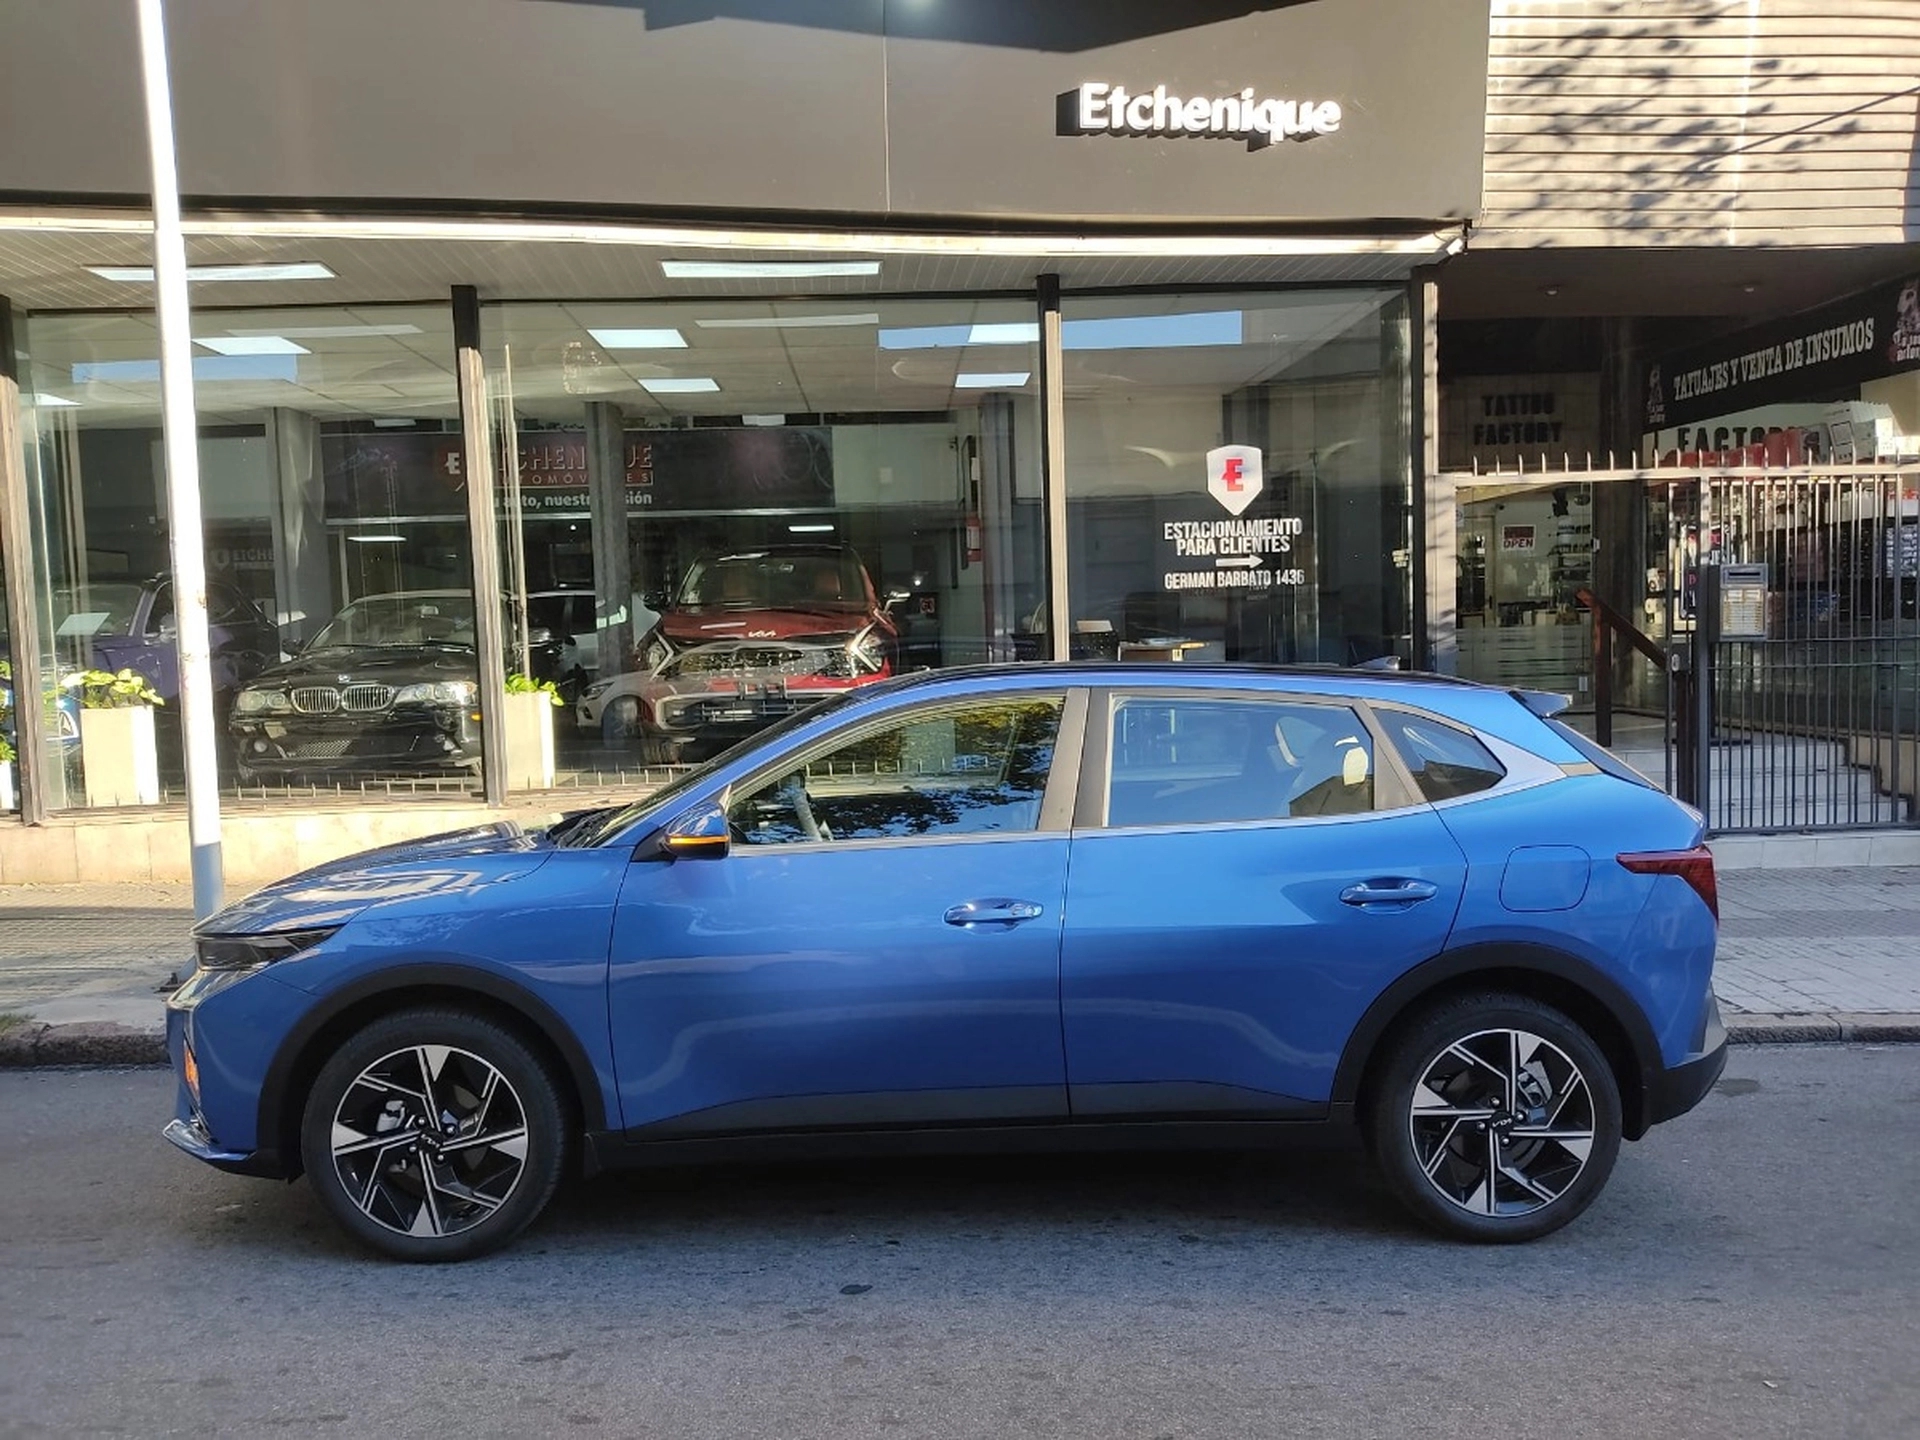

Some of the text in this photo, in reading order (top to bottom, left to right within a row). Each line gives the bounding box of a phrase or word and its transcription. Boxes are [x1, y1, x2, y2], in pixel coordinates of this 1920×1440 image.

[1078, 82, 1342, 144] Etchenique
[1673, 361, 1729, 401] TATUAJES
[1730, 358, 1739, 386] Y
[1741, 344, 1783, 382] VENTA
[1785, 338, 1803, 370] DE
[1805, 317, 1875, 365] INSUMOS
[1677, 426, 1798, 453] FACTO
[1164, 517, 1302, 540] ESTACIONAMIENTO
[1176, 535, 1290, 556] PARA CLIENTES
[1503, 538, 1534, 549] OPEN
[1164, 568, 1304, 589] GERMAN BARBATO 1436
